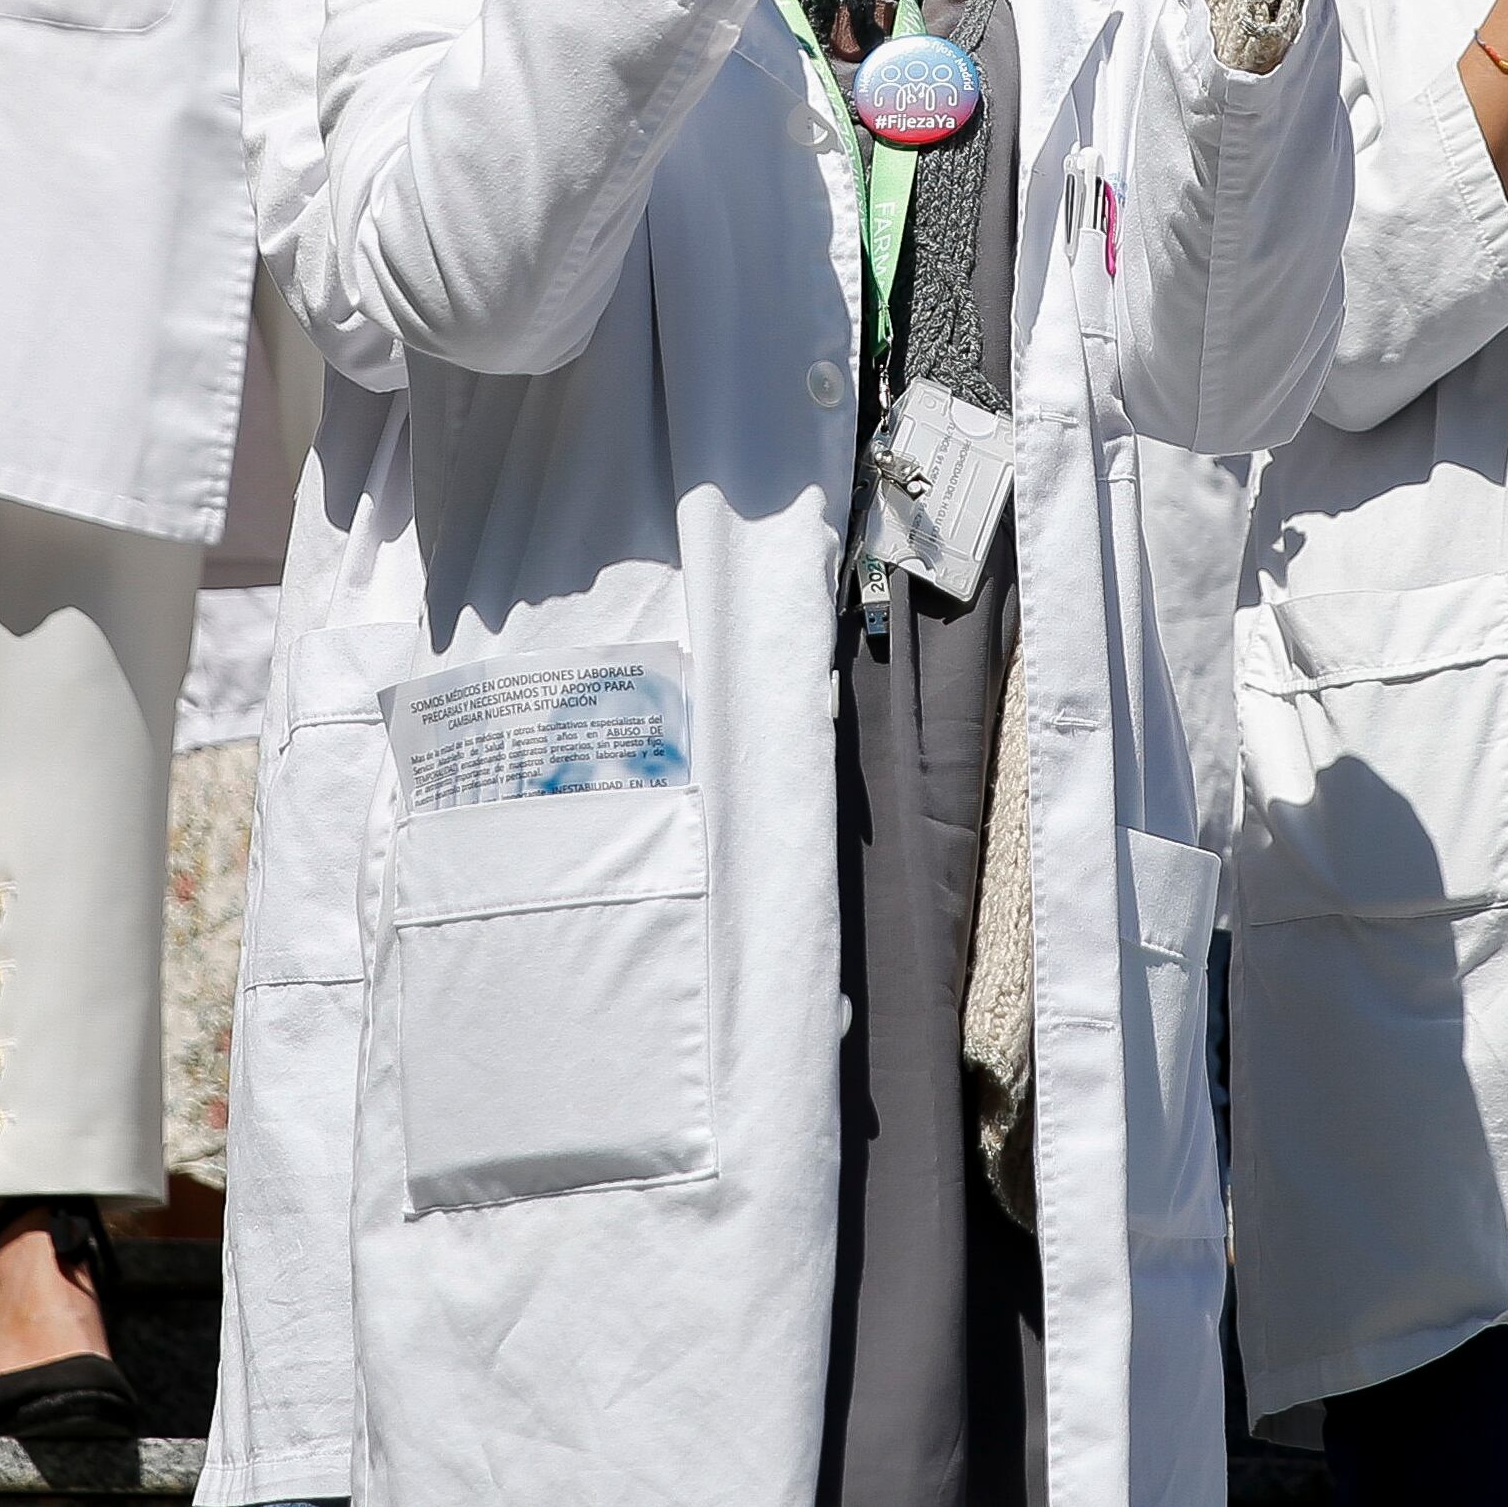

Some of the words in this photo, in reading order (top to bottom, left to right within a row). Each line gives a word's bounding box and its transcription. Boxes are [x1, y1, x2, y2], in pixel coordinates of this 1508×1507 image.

[955, 58, 975, 91] Madrid
[875, 114, 956, 132] #FijezaYa
[410, 695, 444, 713] SOMOS
[446, 682, 481, 703] MÉDICOS
[482, 680, 495, 692] EN
[497, 670, 575, 689] CONDICIONES
[577, 665, 645, 680] LABORALES
[470, 687, 539, 709] NECESITAMOS
[541, 685, 557, 696] TU
[561, 682, 602, 695] APOYO
[604, 680, 635, 692] PARA
[485, 702, 532, 720] NUESTRA
[534, 694, 597, 711] SITUACIÓN
[590, 716, 646, 729] especialistas
[648, 714, 663, 724] del
[557, 731, 578, 741] años
[606, 726, 641, 737] ABUSO
[650, 725, 664, 735] DE
[597, 740, 611, 749] sin
[613, 738, 644, 749] puesto
[550, 753, 590, 764] derechos
[596, 749, 637, 760] laborales
[653, 748, 665, 756] de
[630, 779, 643, 789] EN
[650, 778, 668, 788] LAS
